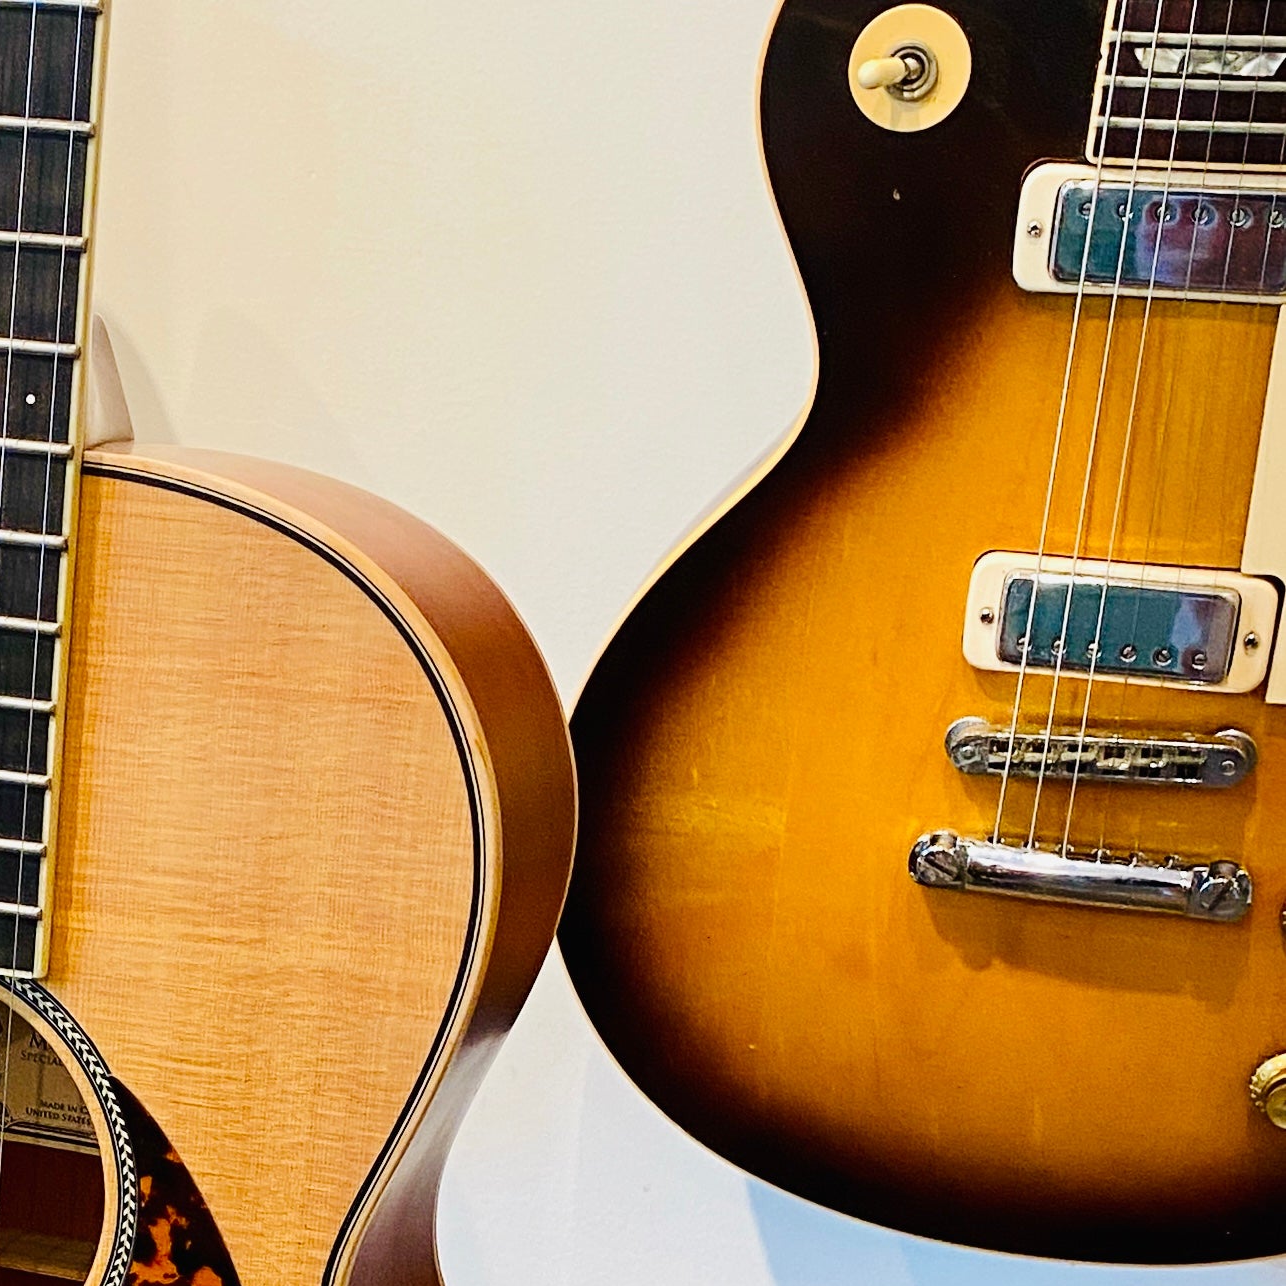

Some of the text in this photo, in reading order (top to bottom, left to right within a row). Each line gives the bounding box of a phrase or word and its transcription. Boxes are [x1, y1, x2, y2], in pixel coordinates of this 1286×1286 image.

[67, 1104, 78, 1113] IN
[26, 1107, 90, 1125] UNITED STATES
